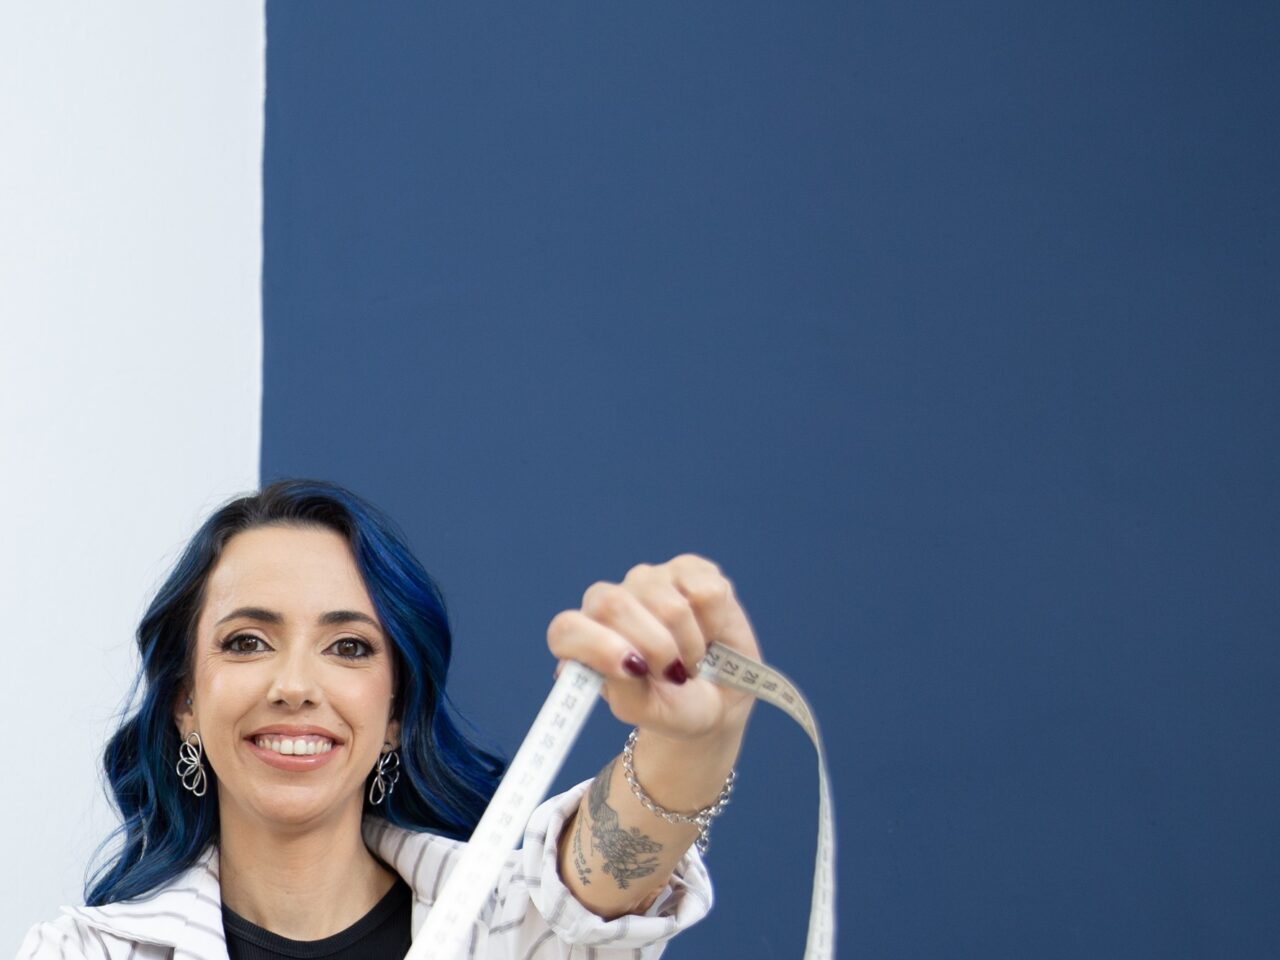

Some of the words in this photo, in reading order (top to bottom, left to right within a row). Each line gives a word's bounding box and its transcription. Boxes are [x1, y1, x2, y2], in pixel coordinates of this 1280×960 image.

[703, 650, 720, 668] 22
[721, 659, 740, 677] 21
[741, 669, 760, 685] 20
